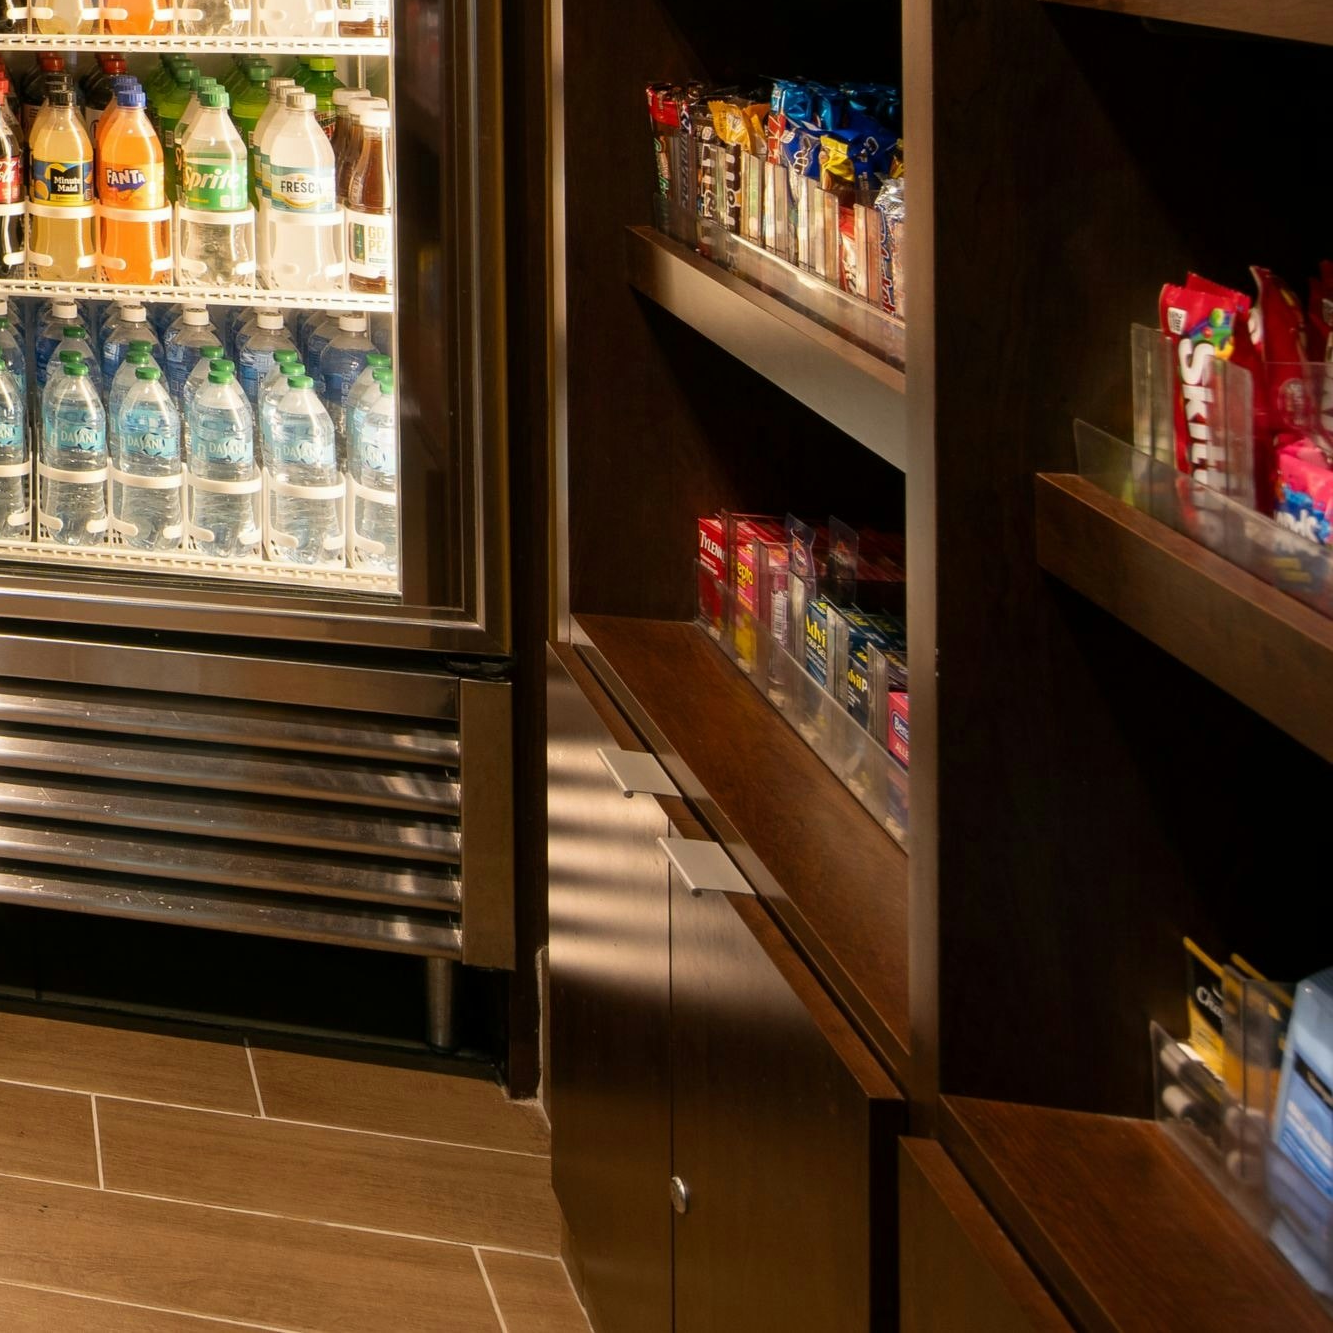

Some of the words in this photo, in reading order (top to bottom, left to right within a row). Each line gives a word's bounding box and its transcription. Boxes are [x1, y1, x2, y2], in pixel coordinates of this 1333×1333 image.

[106, 168, 147, 186] FANTA
[183, 166, 240, 191] Sprite
[56, 183, 78, 193] Maid
[60, 427, 97, 444] DASANI
[127, 434, 165, 452] DASANI
[699, 530, 725, 563] TYLEN
[805, 614, 827, 649] Advi
